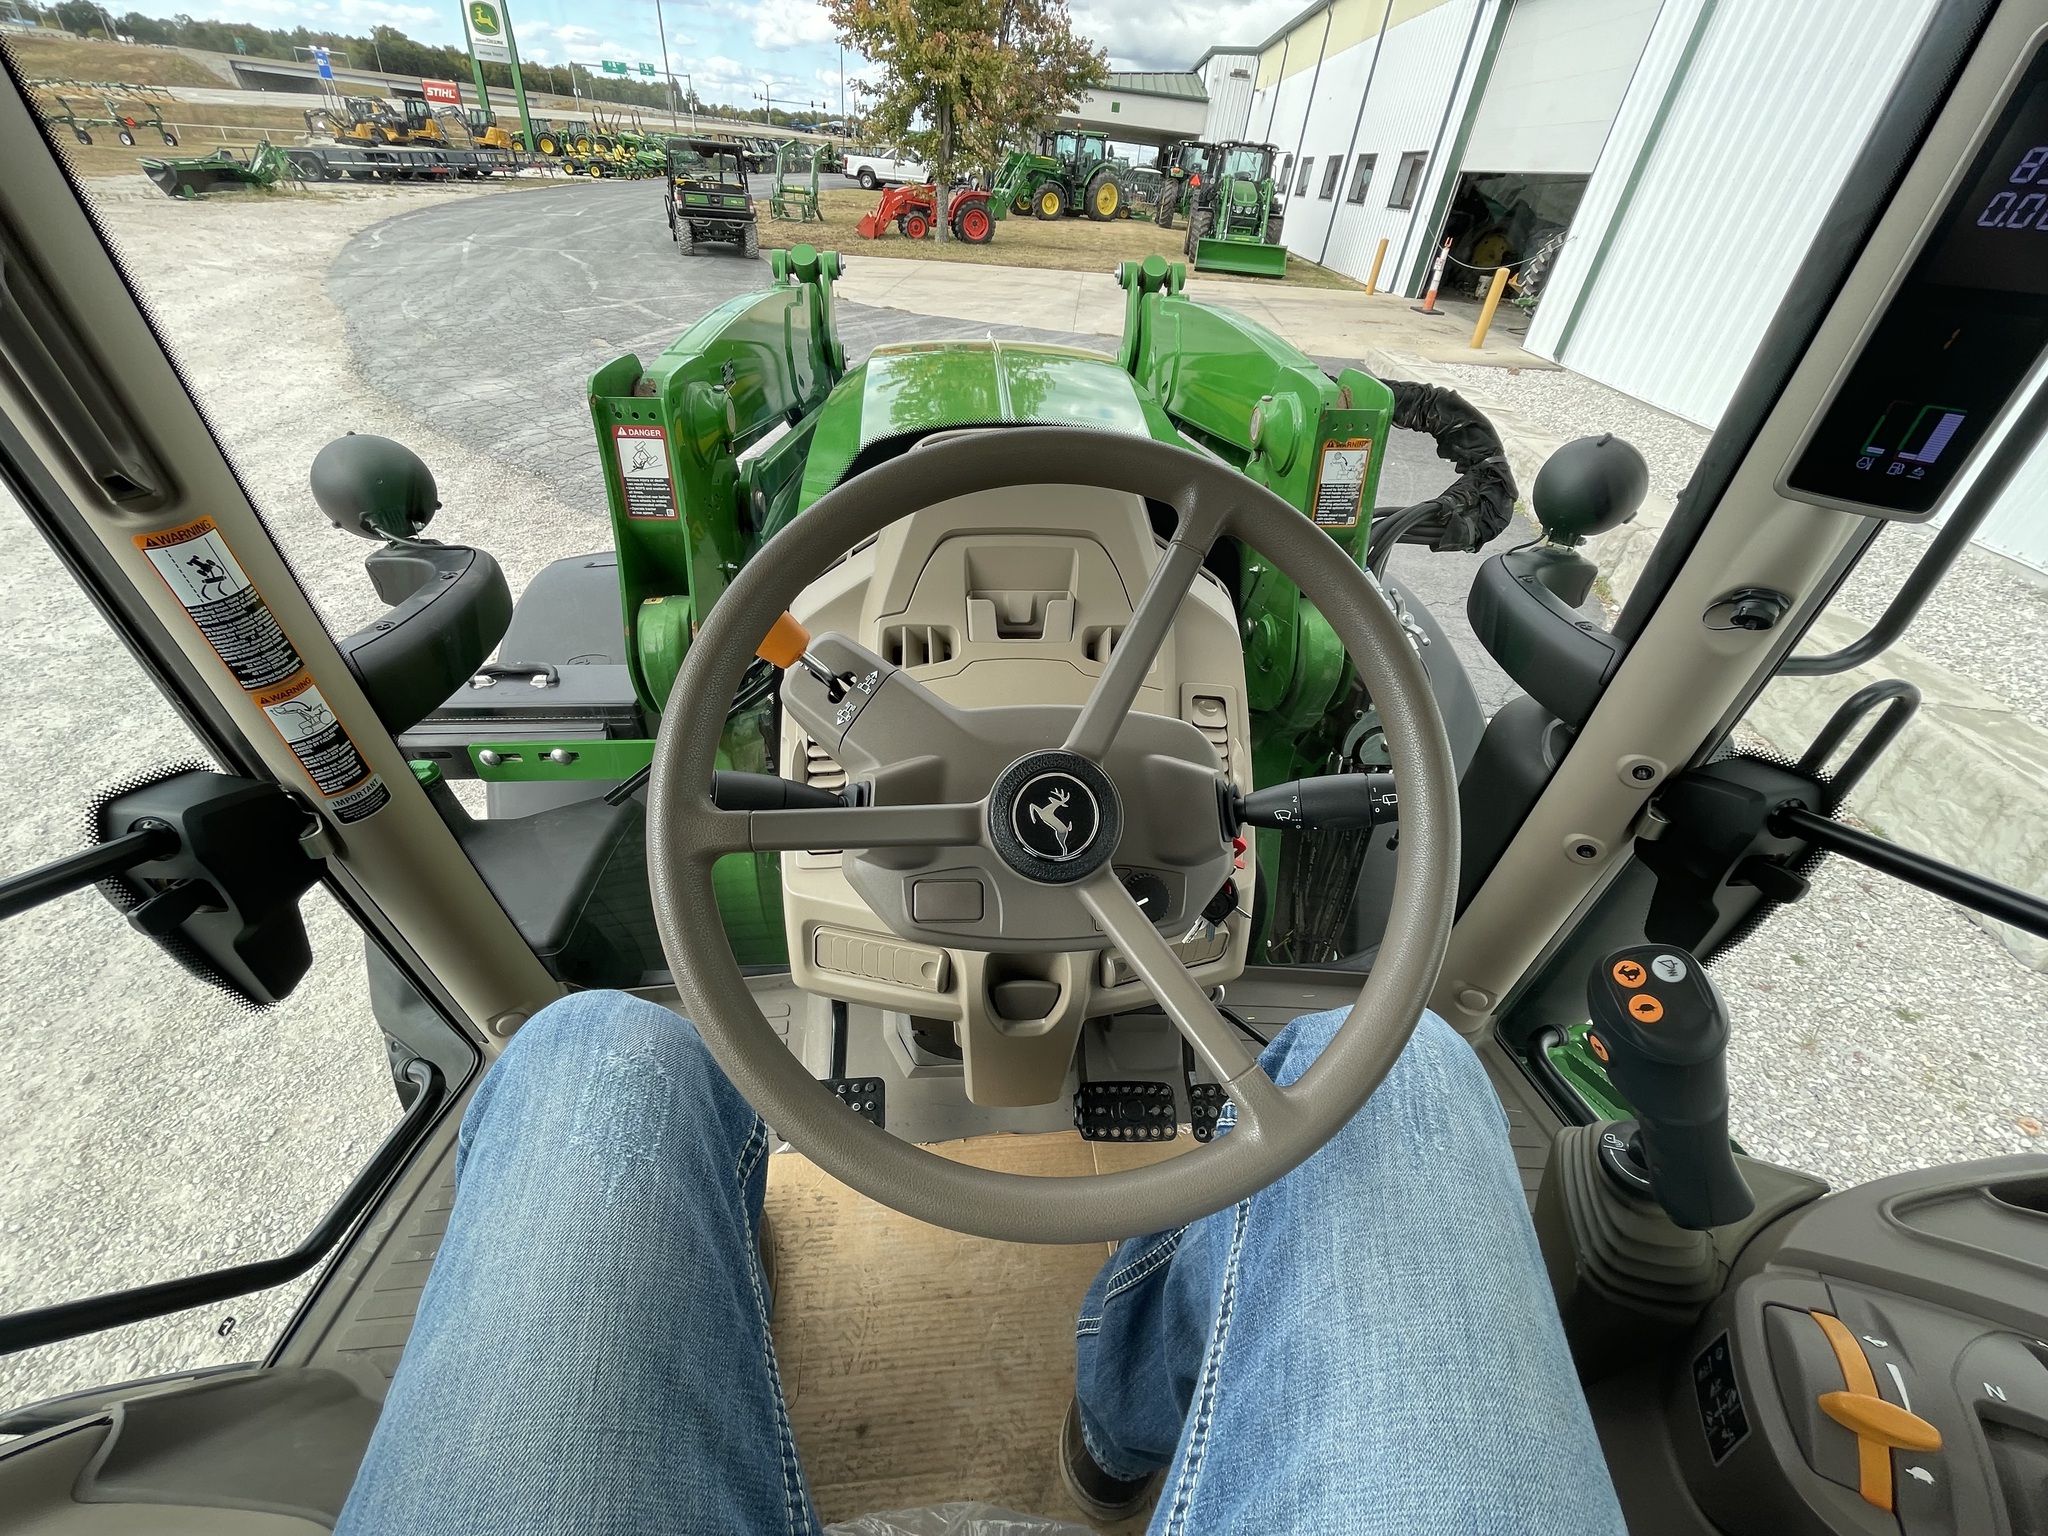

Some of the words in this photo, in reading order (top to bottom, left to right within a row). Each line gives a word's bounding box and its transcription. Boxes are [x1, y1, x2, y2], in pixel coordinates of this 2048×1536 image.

[427, 86, 455, 99] STIHL
[2009, 147, 2048, 184] 8
[628, 429, 661, 437] DANGER
[156, 520, 211, 545] WARNING
[269, 677, 312, 702] WARNING
[332, 778, 379, 808] IMPORTANT
[1292, 795, 1298, 803] 2
[1983, 1382, 2007, 1401] N
